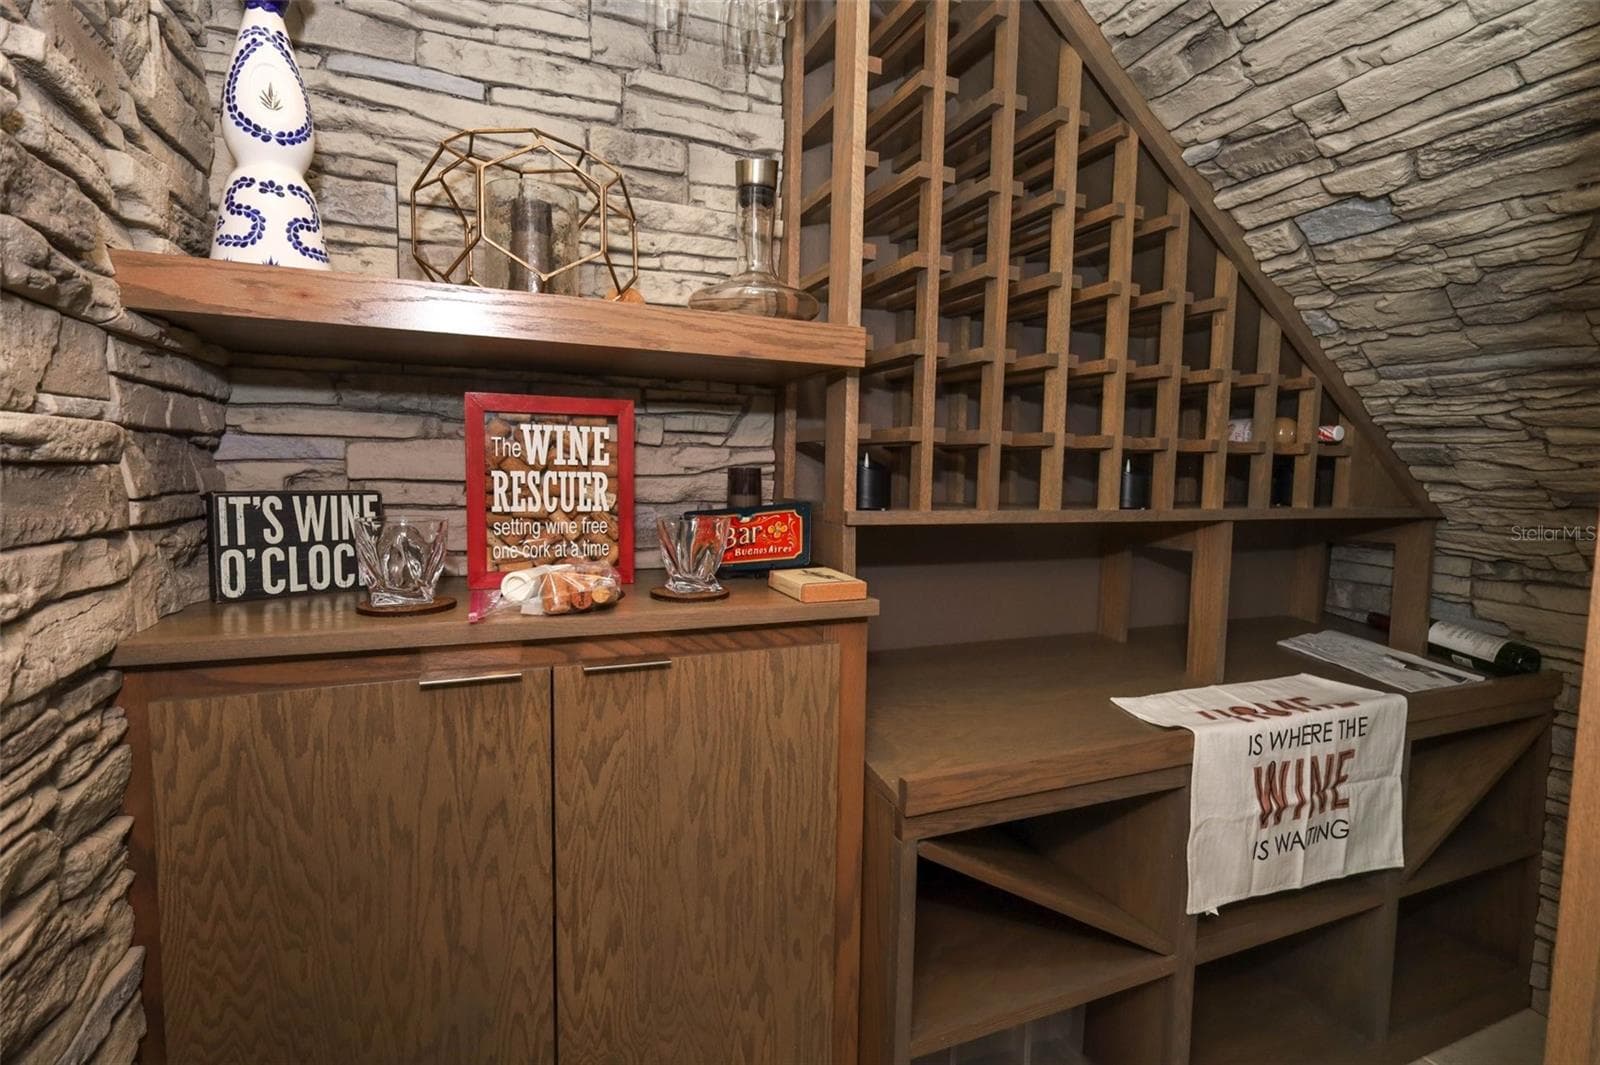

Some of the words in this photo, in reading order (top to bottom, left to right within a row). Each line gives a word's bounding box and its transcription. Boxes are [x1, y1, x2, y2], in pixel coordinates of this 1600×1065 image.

[490, 436, 522, 458] The
[520, 423, 610, 466] WINE
[490, 470, 611, 513] RESCUER
[217, 495, 285, 546] IT'S
[493, 518, 541, 539] setting
[545, 521, 578, 535] wine
[581, 517, 609, 535] free
[219, 543, 368, 598] O'CLOC
[492, 545, 518, 560] one
[522, 540, 551, 558] cork
[554, 543, 568, 557] at
[570, 544, 580, 557] a
[583, 540, 610, 557] time
[1248, 733, 1263, 756] IS
[1270, 721, 1333, 751] WHERE
[1339, 716, 1369, 740] THE
[1253, 749, 1356, 830] WINE
[1252, 840, 1270, 861] IS
[1274, 819, 1350, 855] WAITING
